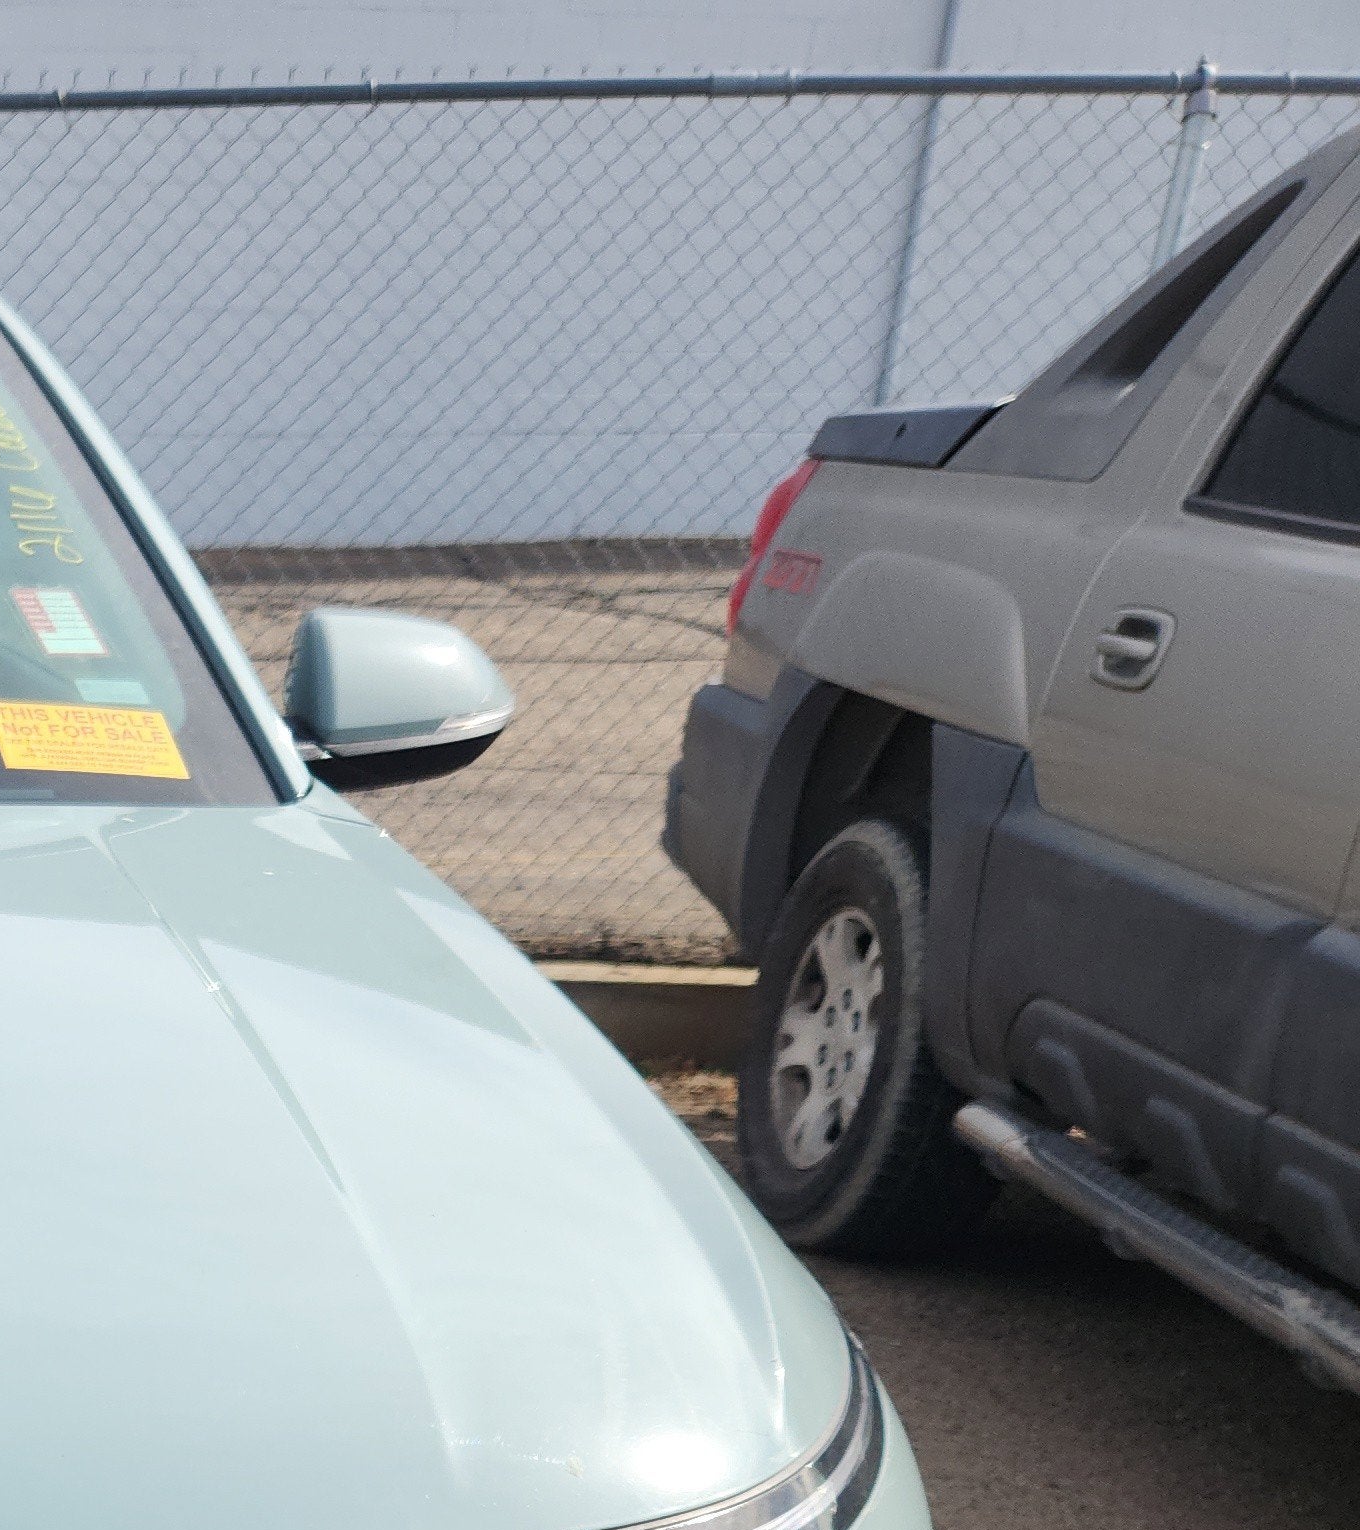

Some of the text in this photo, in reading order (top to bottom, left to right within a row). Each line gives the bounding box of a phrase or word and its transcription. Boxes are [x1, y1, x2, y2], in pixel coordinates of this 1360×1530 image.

[56, 708, 159, 730] VEHICLE
[2, 722, 168, 745] Not FOR SALE
